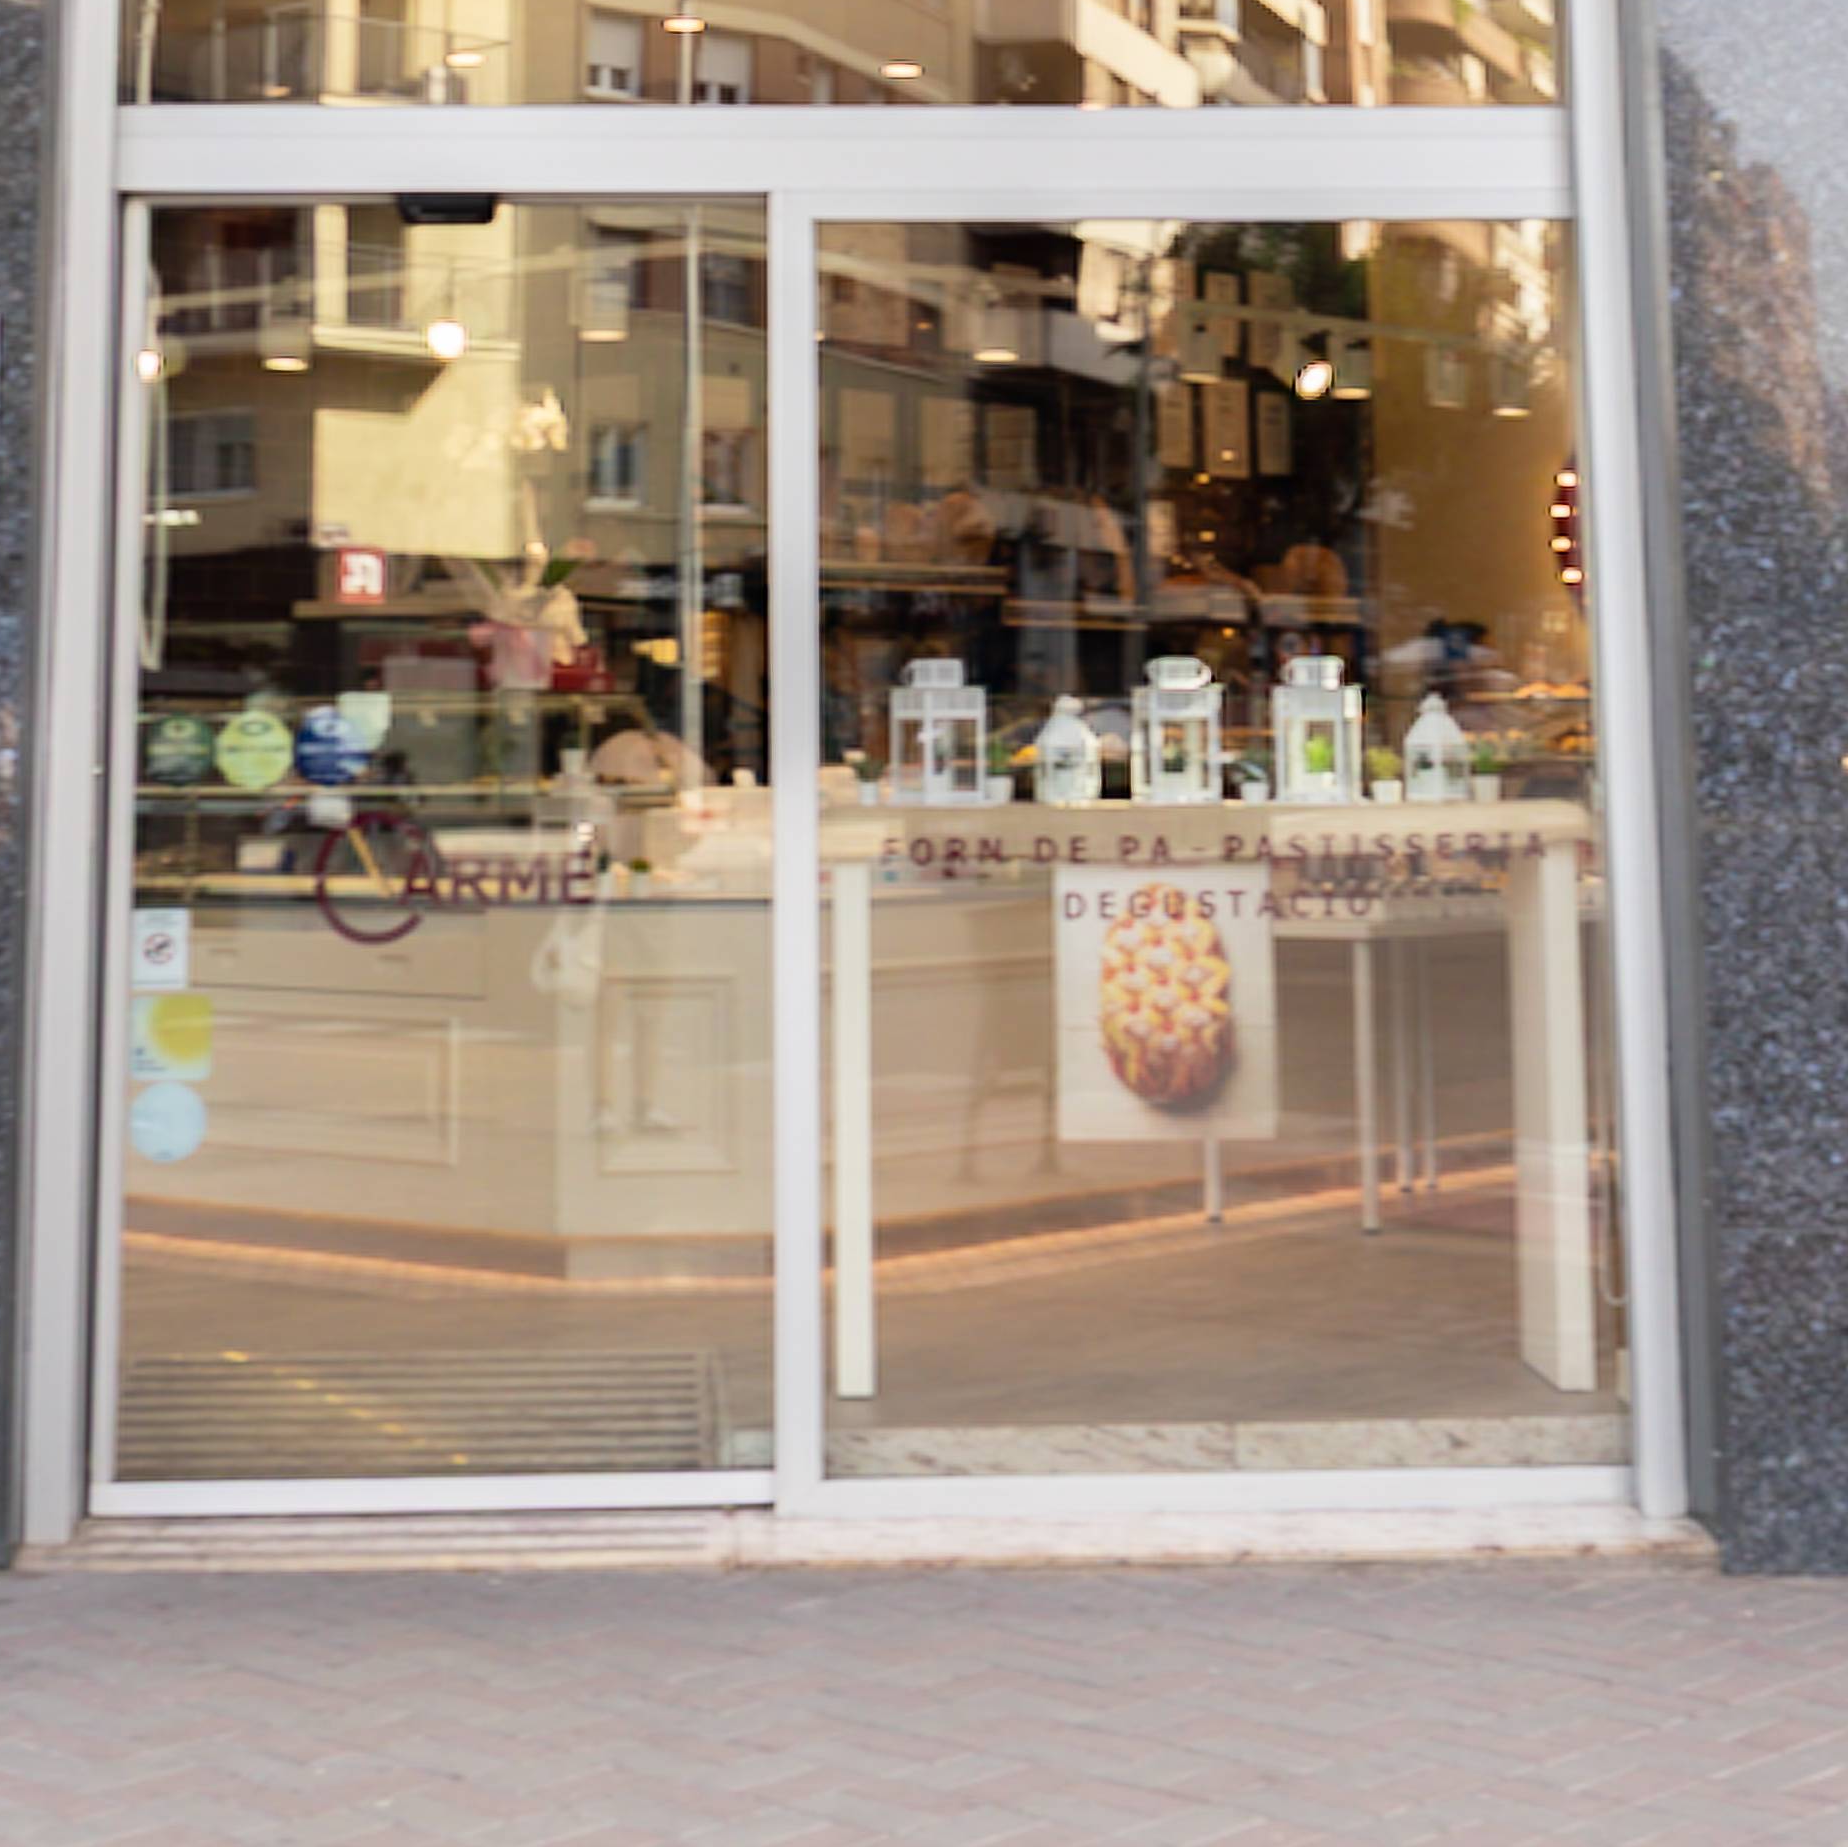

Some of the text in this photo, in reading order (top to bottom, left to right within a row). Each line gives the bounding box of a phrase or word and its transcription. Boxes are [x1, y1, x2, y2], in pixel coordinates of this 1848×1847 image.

[314, 809, 595, 945] CARME
[880, 836, 1003, 867] FORN
[1032, 835, 1089, 865] DE
[1117, 835, 1173, 865] PA
[1220, 832, 1546, 863] PASTISSERIA
